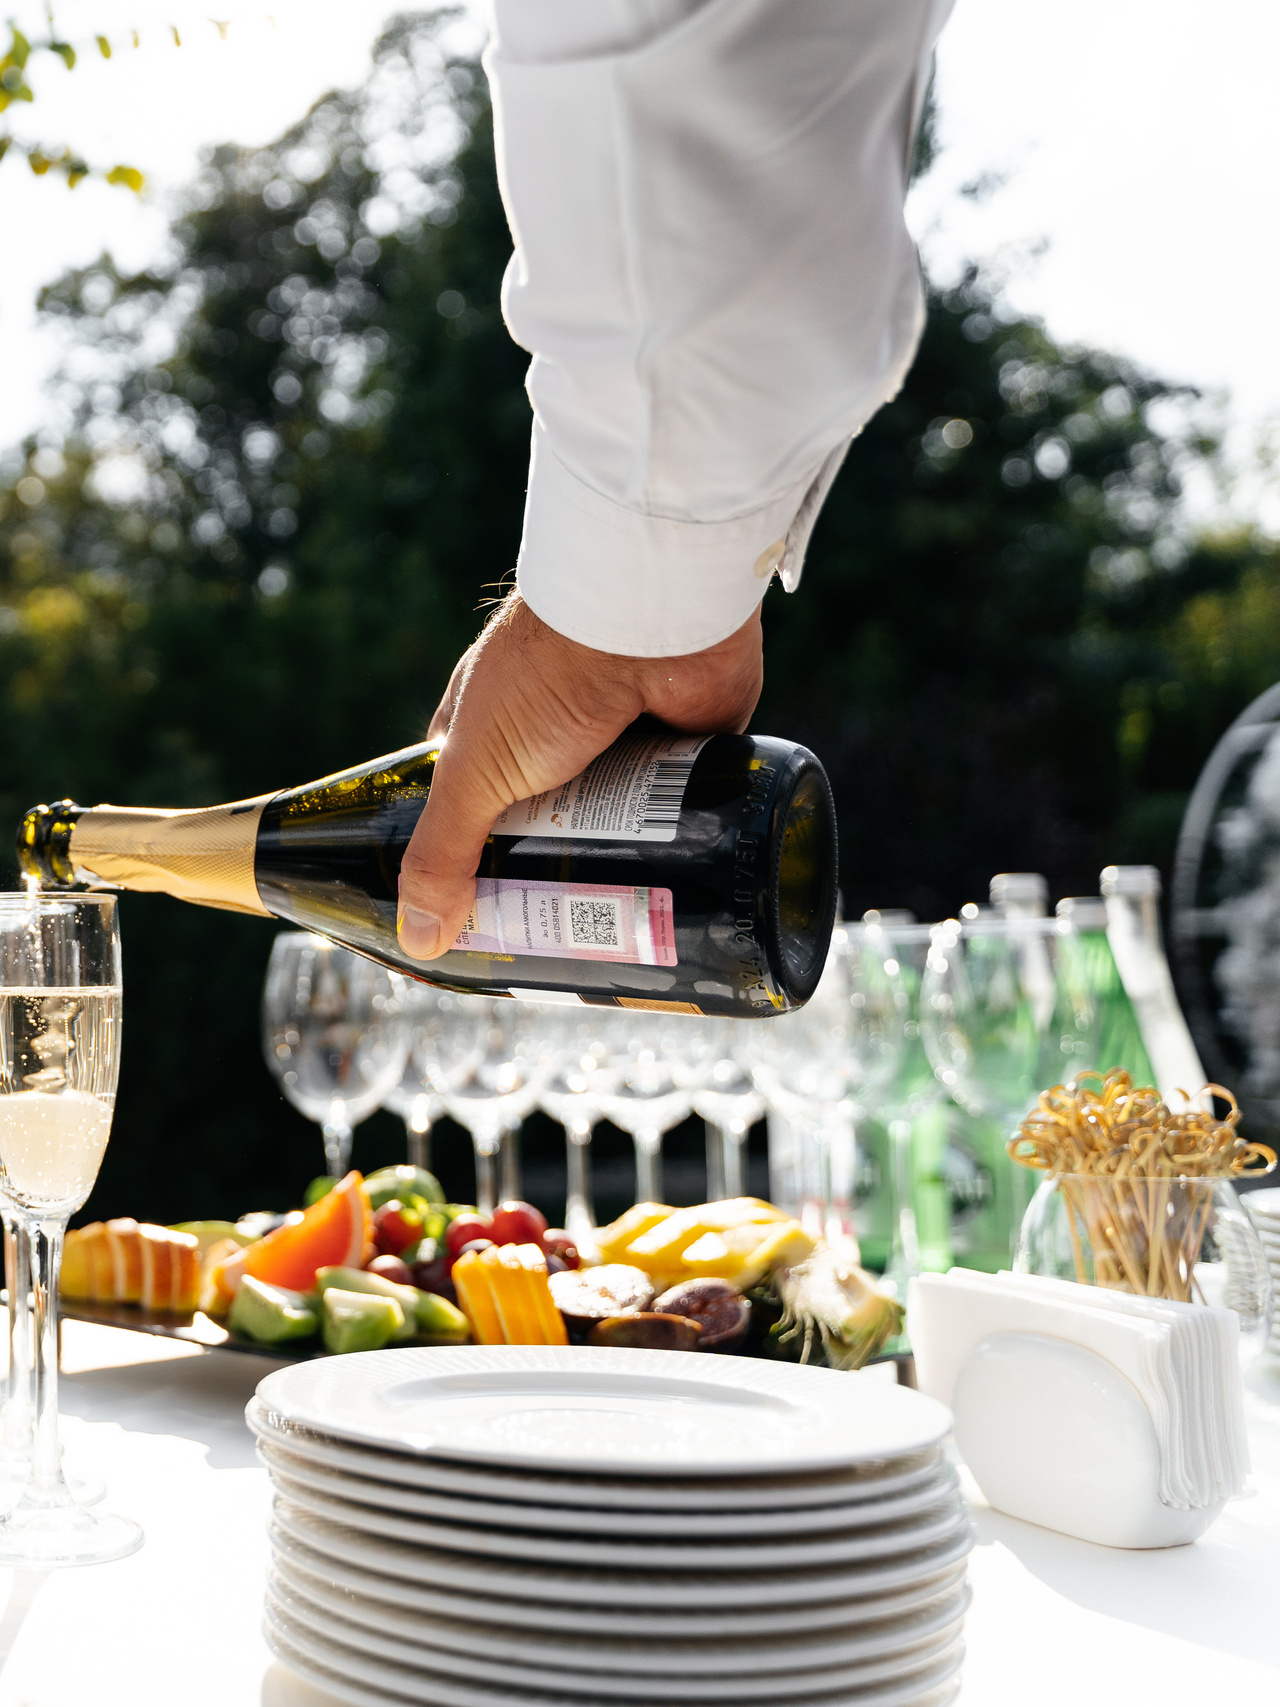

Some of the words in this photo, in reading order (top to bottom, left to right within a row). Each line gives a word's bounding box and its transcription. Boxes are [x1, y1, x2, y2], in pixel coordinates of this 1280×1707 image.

[635, 792, 649, 825] 670025
[643, 761, 660, 788] 471152
[522, 888, 530, 926] АЛКОГОЛЬНЫЕ
[540, 908, 548, 927] 0,75
[524, 927, 533, 949] НАПИТКИ
